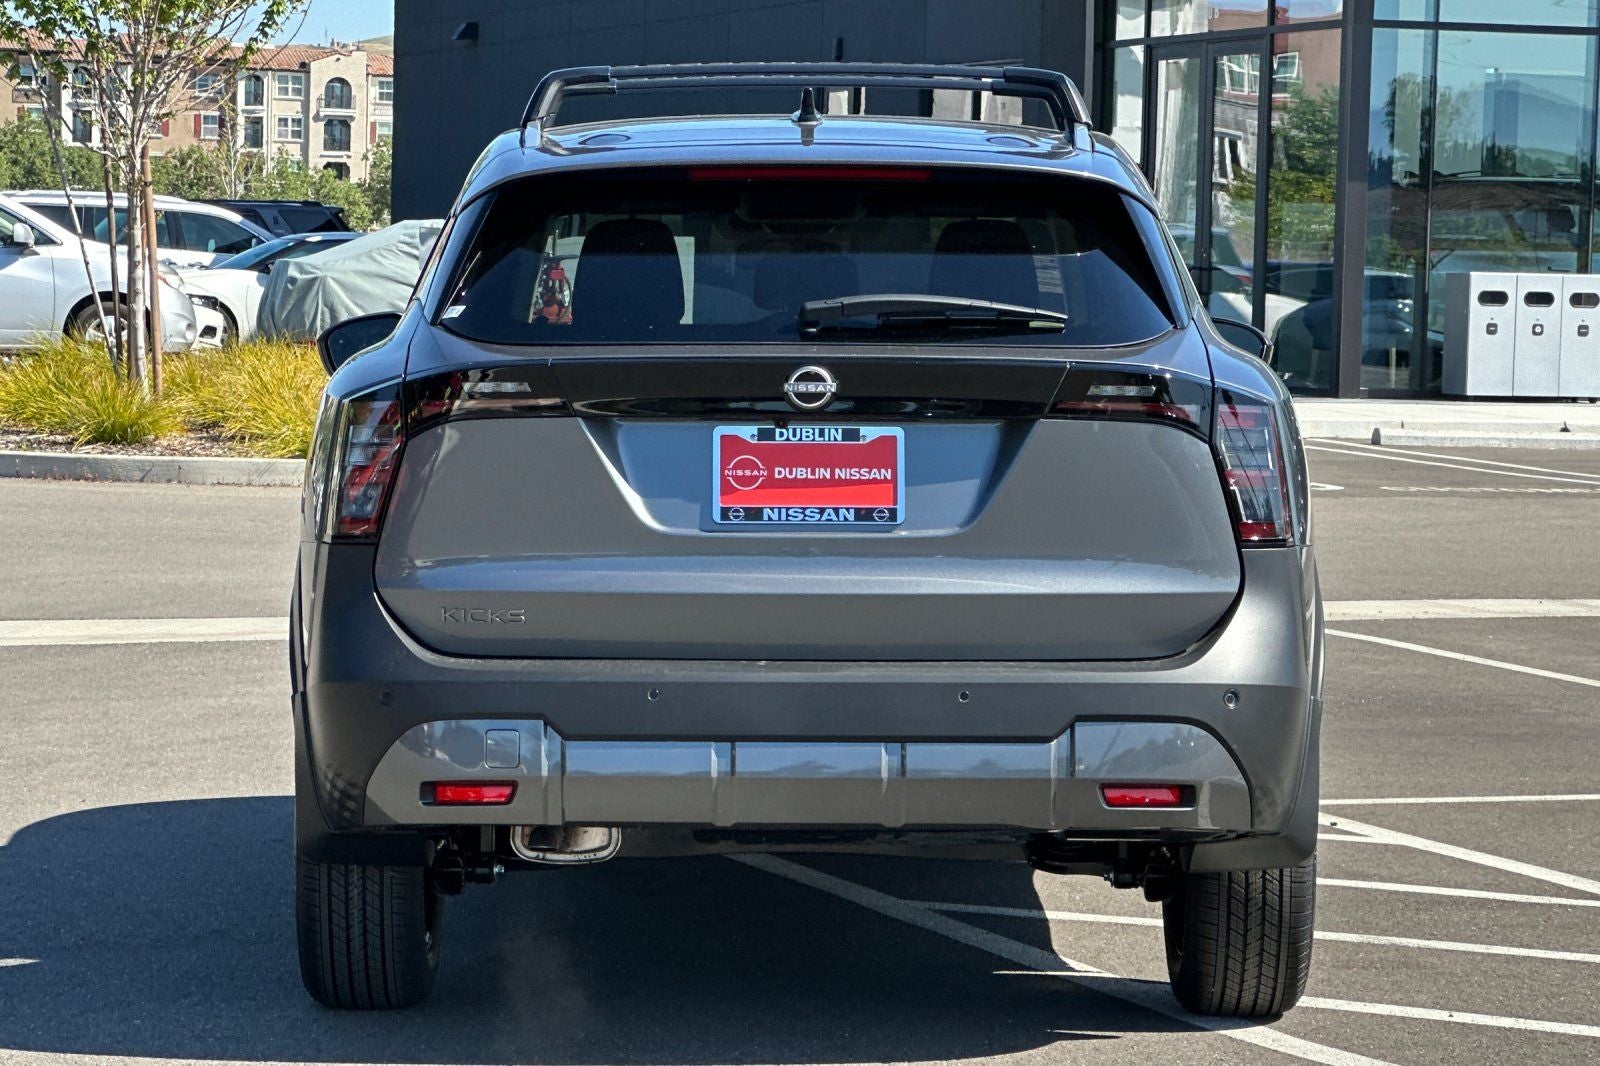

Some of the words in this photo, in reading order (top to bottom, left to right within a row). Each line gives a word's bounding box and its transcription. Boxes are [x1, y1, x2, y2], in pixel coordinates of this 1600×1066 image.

[784, 384, 836, 392] NISSAN
[775, 428, 843, 441] DUBLIN
[774, 467, 830, 479] DUBLIN
[835, 468, 891, 480] NISSAN
[763, 508, 855, 521] NISSAN
[441, 606, 526, 624] KICKS
